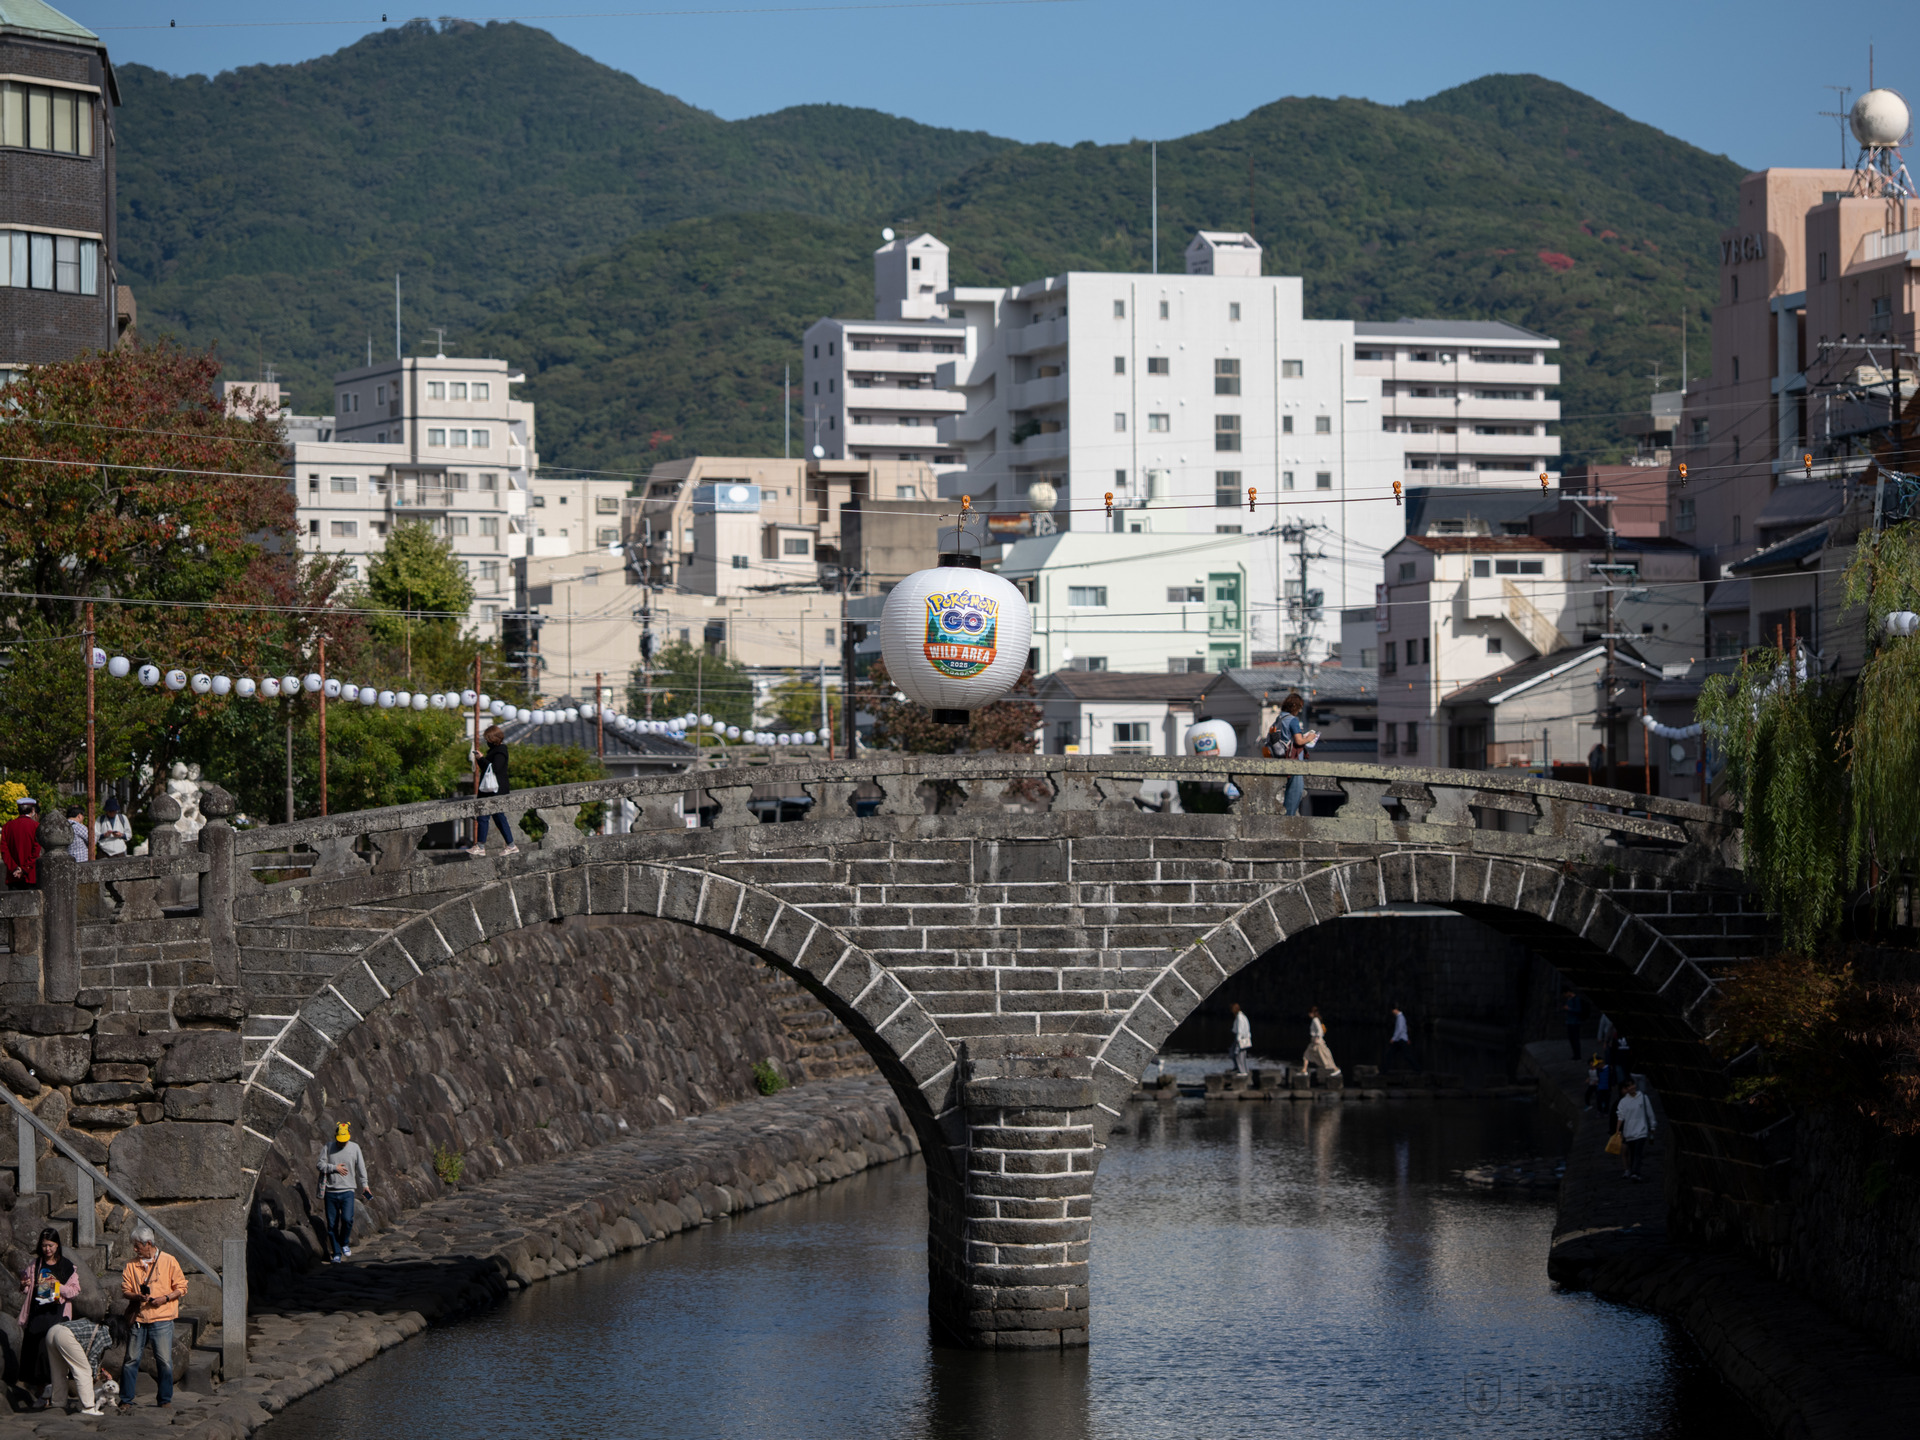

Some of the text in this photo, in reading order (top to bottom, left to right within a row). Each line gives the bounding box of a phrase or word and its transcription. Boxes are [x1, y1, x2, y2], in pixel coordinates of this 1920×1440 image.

[1720, 233, 1764, 265] VEGA
[942, 610, 985, 633] GO
[929, 645, 990, 663] WILD AREA
